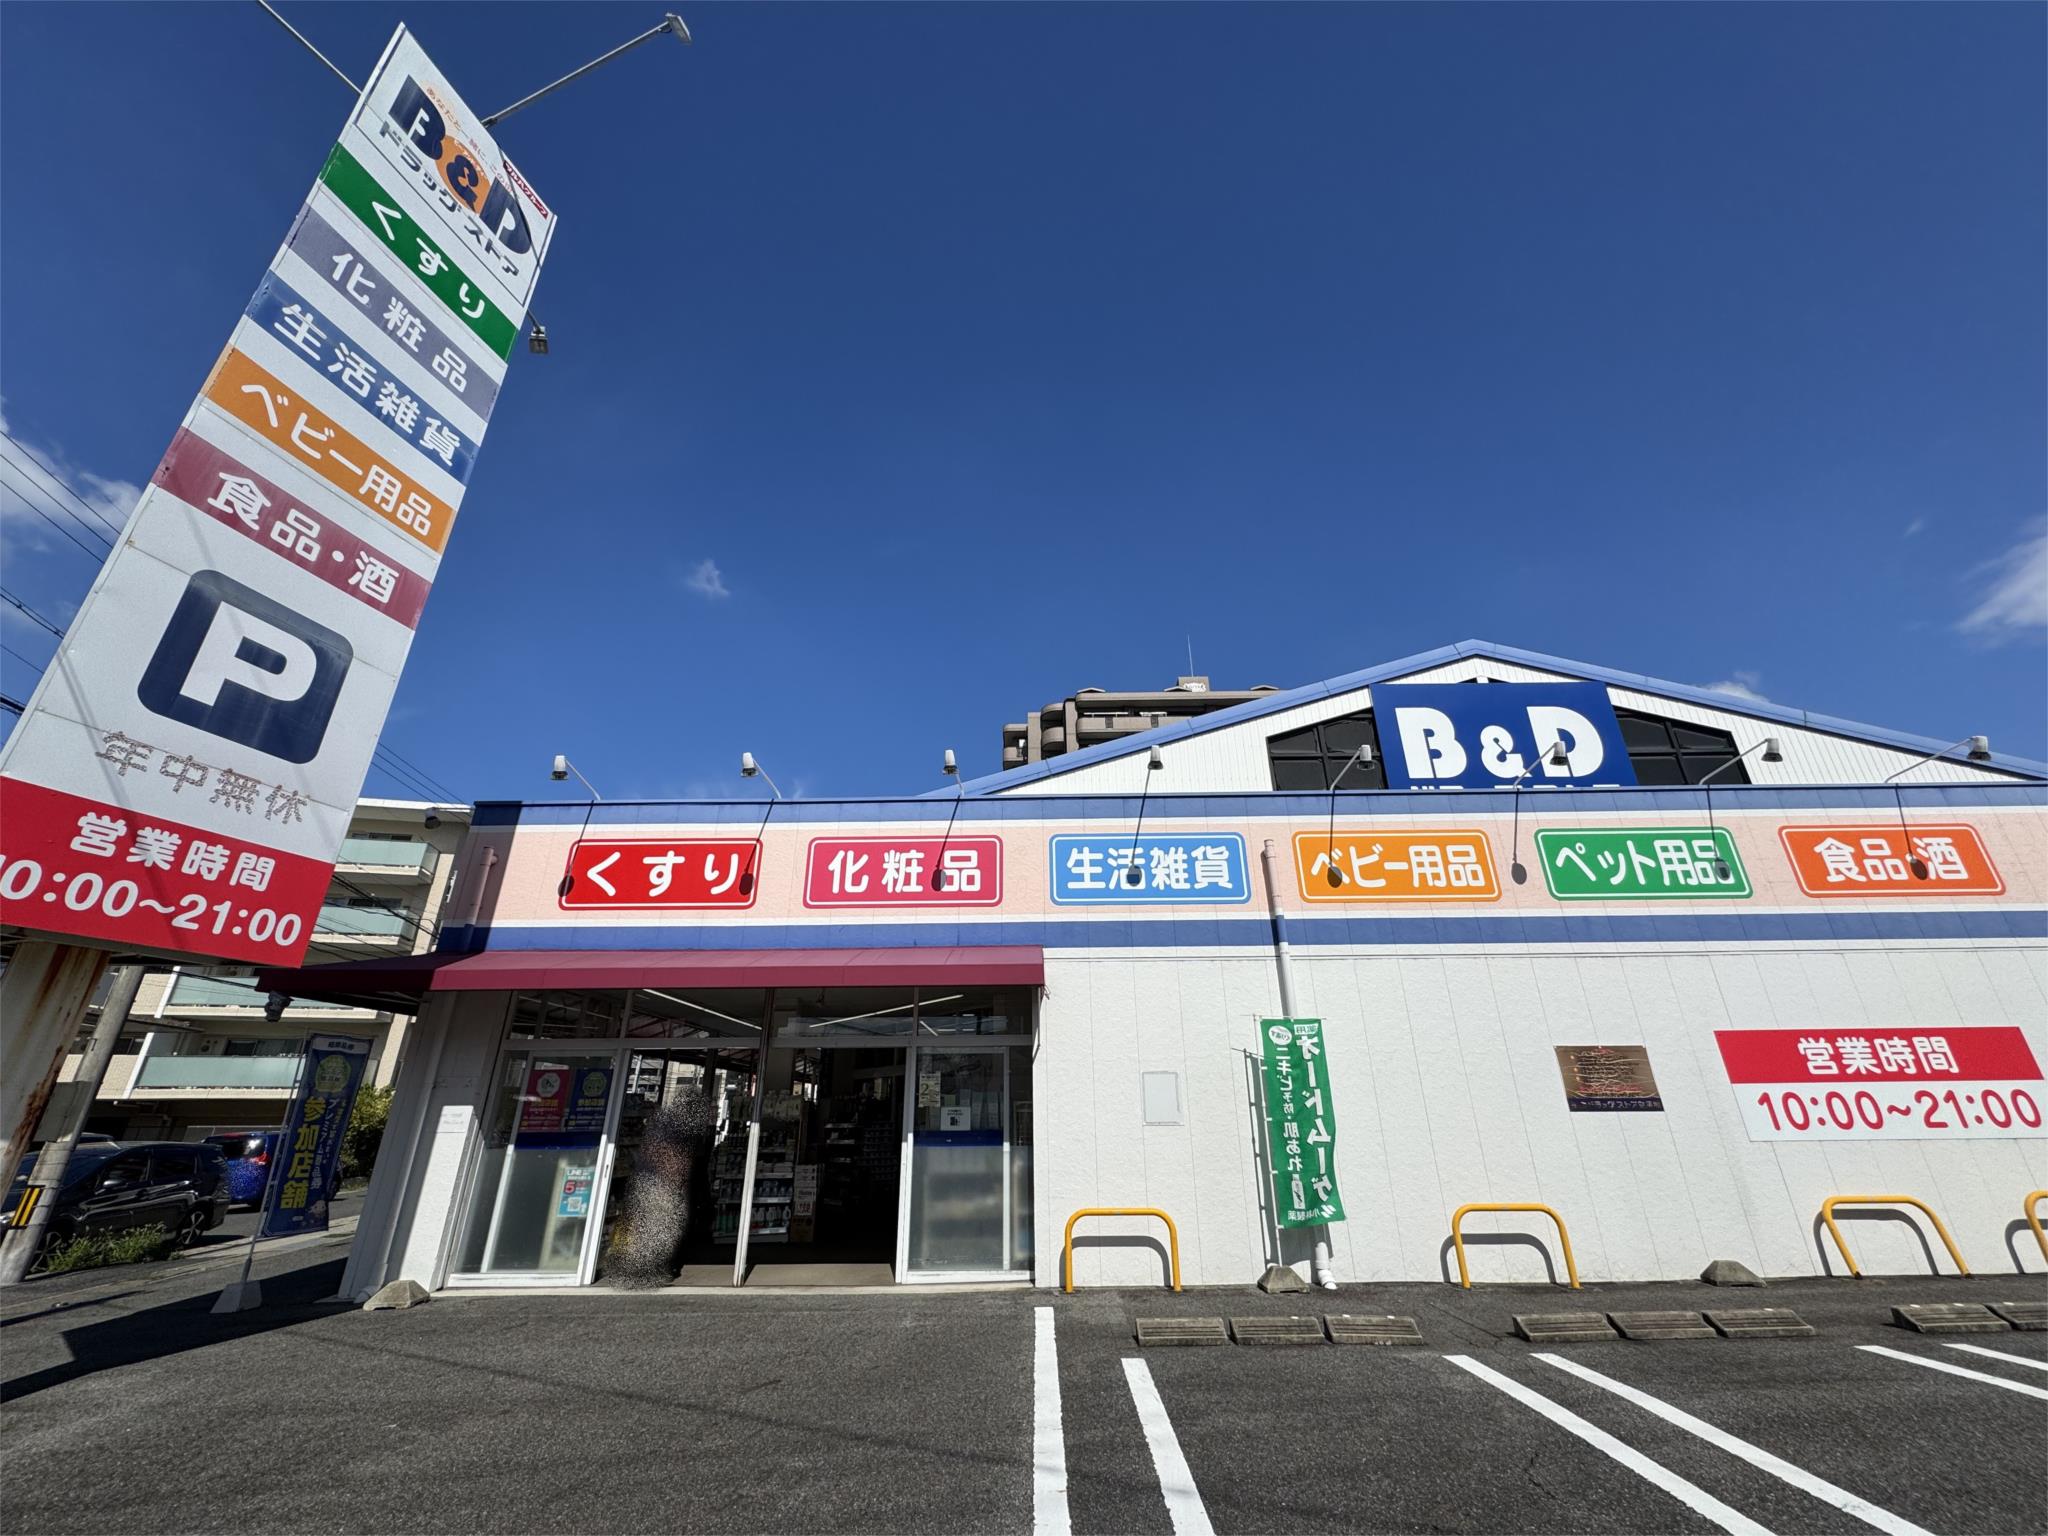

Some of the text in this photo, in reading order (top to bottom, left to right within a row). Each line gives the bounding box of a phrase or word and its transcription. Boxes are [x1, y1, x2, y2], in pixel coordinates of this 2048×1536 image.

[378, 121, 520, 277] ドラッグストア
[388, 74, 532, 254] B&D
[371, 200, 486, 320] くすり
[331, 251, 467, 393] 化粧品
[274, 303, 461, 467] 生活雑貨
[242, 382, 433, 537] ベビー用品
[207, 471, 400, 604] 食品・酒
[179, 600, 318, 707] P
[95, 731, 313, 825] 年中無休
[1394, 705, 1604, 779] B&D
[70, 811, 277, 892] 営業時間
[586, 850, 740, 897] くすり
[827, 848, 982, 895] 化粧品
[1065, 844, 1234, 891] 生活雑貨
[1310, 843, 1486, 888] ベビー用品
[1555, 839, 1735, 887] ペット用品
[1813, 836, 1970, 884] 食品・酒
[0, 854, 302, 948] 0:00~21:00
[1796, 1035, 1960, 1076] 営業時間
[279, 1095, 327, 1209] 参加店舗
[1756, 1087, 2043, 1131] 10:00~21:00
